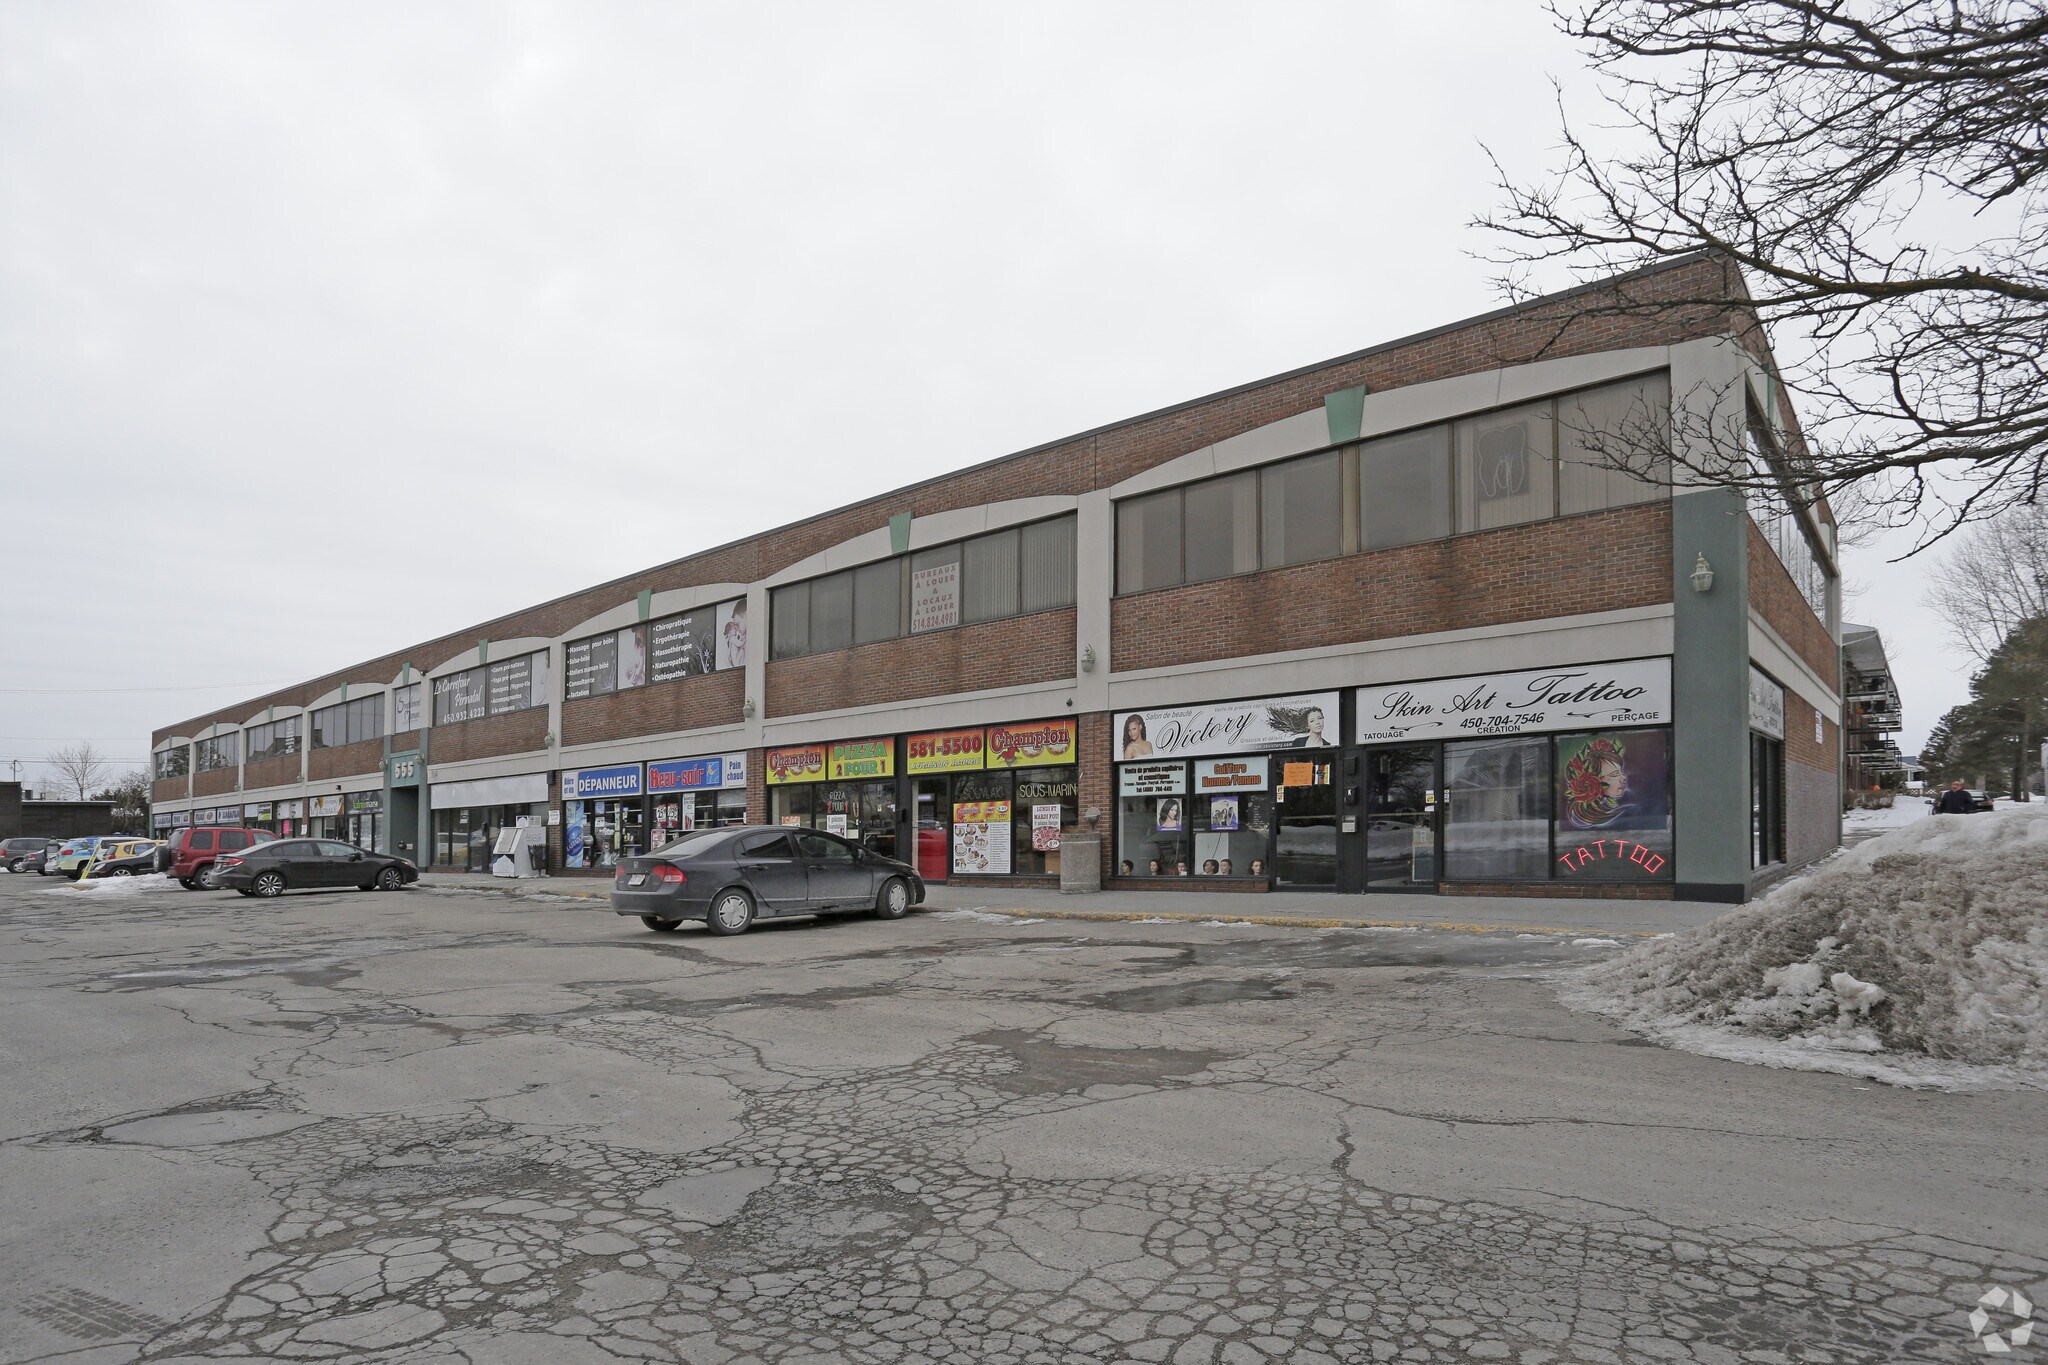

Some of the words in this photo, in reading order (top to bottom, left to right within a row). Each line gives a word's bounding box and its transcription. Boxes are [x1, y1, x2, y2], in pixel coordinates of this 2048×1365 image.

[914, 565, 956, 580] BUREAUX
[926, 575, 955, 586] LOUER
[917, 593, 953, 606] LOCAUX
[925, 602, 954, 614] LOUER
[655, 615, 692, 632] Chiropratique
[655, 630, 690, 645] Ergothérapie
[569, 643, 589, 654] Massage
[655, 643, 692, 657] Massothérapie
[654, 656, 690, 670] Naturopathie
[654, 669, 686, 681] Ostéopathie
[1374, 691, 1435, 720] Skin
[1442, 684, 1497, 714] Art
[1506, 671, 1648, 708] Tattoo
[1145, 712, 1160, 721] Salon
[1161, 711, 1170, 719] de
[1171, 709, 1192, 719] beauté
[1460, 711, 1544, 729] 450-704-7546
[1611, 711, 1659, 723] PERÇAGE
[1155, 711, 1258, 755] Victory
[1363, 730, 1404, 740] TATOUAGE
[1476, 723, 1520, 735] CRÉATION
[909, 734, 982, 759] 581-5500
[990, 727, 1069, 753] Champion
[833, 741, 888, 761] PIZZA
[729, 761, 741, 770] Pain
[769, 750, 822, 772] Champion
[836, 763, 843, 777] 2
[843, 761, 878, 776] POUR
[880, 759, 886, 774] 1
[395, 761, 414, 778] 555
[649, 763, 704, 789] Beau-soir
[727, 770, 744, 781] chaud
[578, 774, 637, 792] DÉPANNEUR
[1202, 774, 1262, 788] Homme/Femme
[829, 791, 846, 800] PIZZA
[1559, 839, 1665, 873] TATTOO
